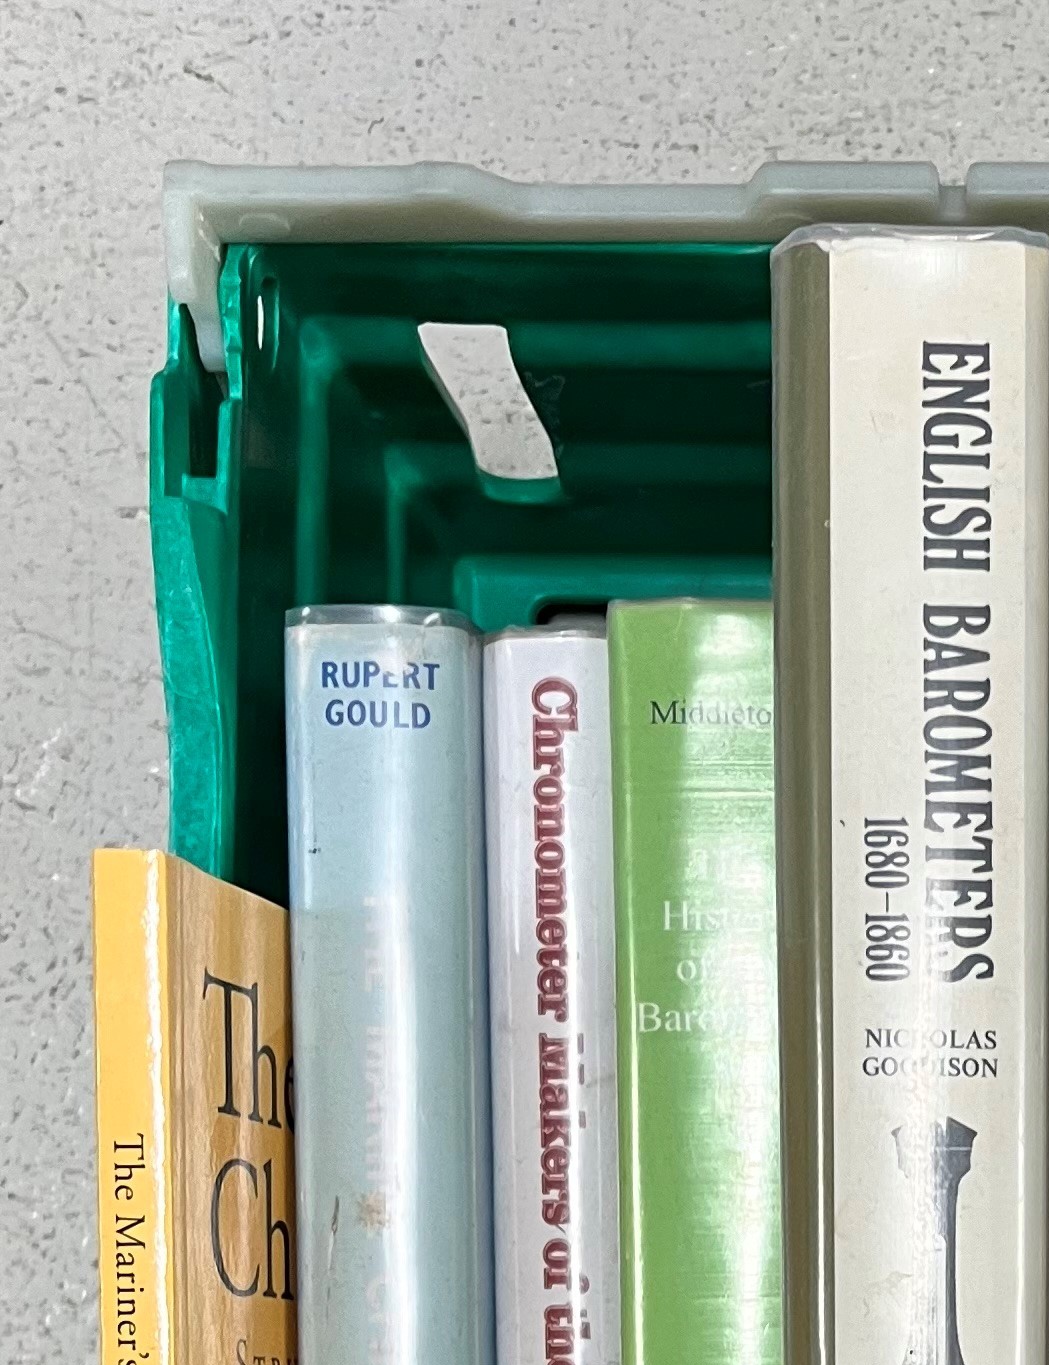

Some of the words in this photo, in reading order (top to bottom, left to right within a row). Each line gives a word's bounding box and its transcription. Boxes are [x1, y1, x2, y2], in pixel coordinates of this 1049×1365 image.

[922, 339, 991, 573] ENGLISH
[325, 698, 431, 730] GOULD
[922, 603, 994, 984] BAROMETERS
[530, 675, 580, 1024] Chronometer
[113, 1133, 147, 1201] The
